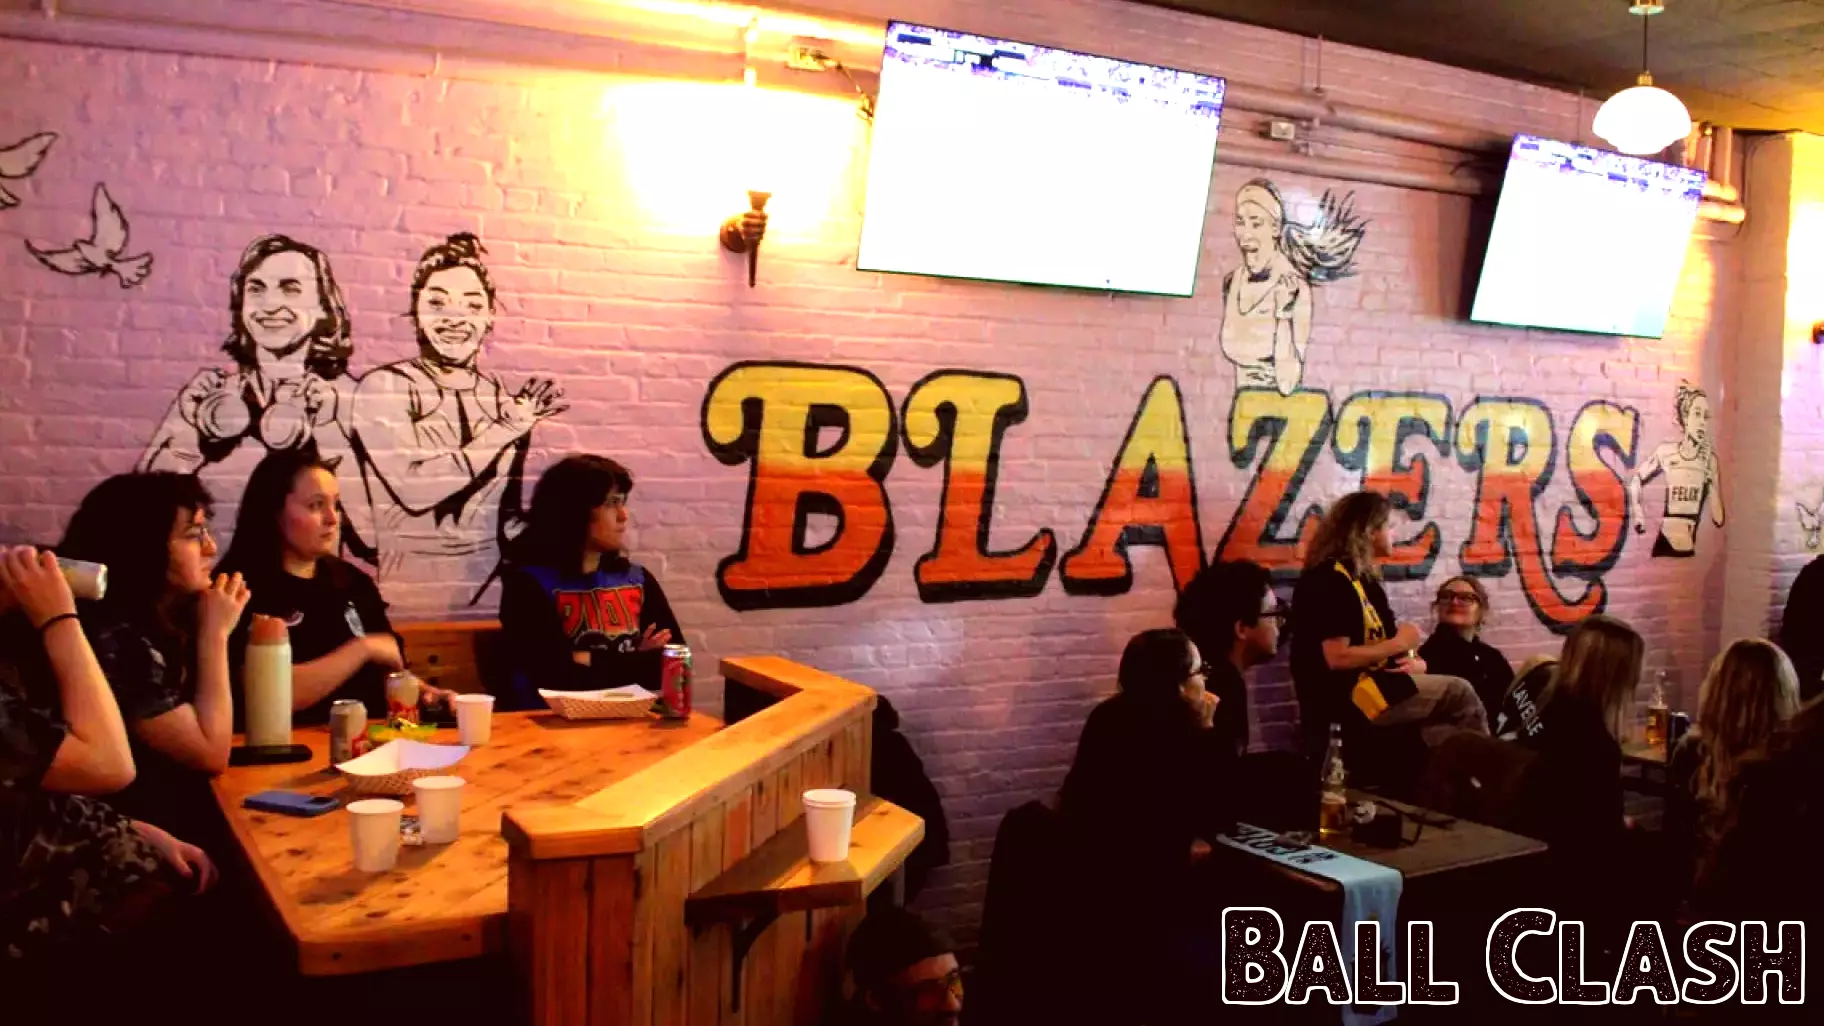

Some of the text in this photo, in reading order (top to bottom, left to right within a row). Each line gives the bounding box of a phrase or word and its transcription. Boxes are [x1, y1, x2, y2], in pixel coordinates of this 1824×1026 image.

[701, 360, 1639, 635] BLAZERS
[1671, 485, 1700, 502] FELIX
[1511, 681, 1545, 737] LAVELLE
